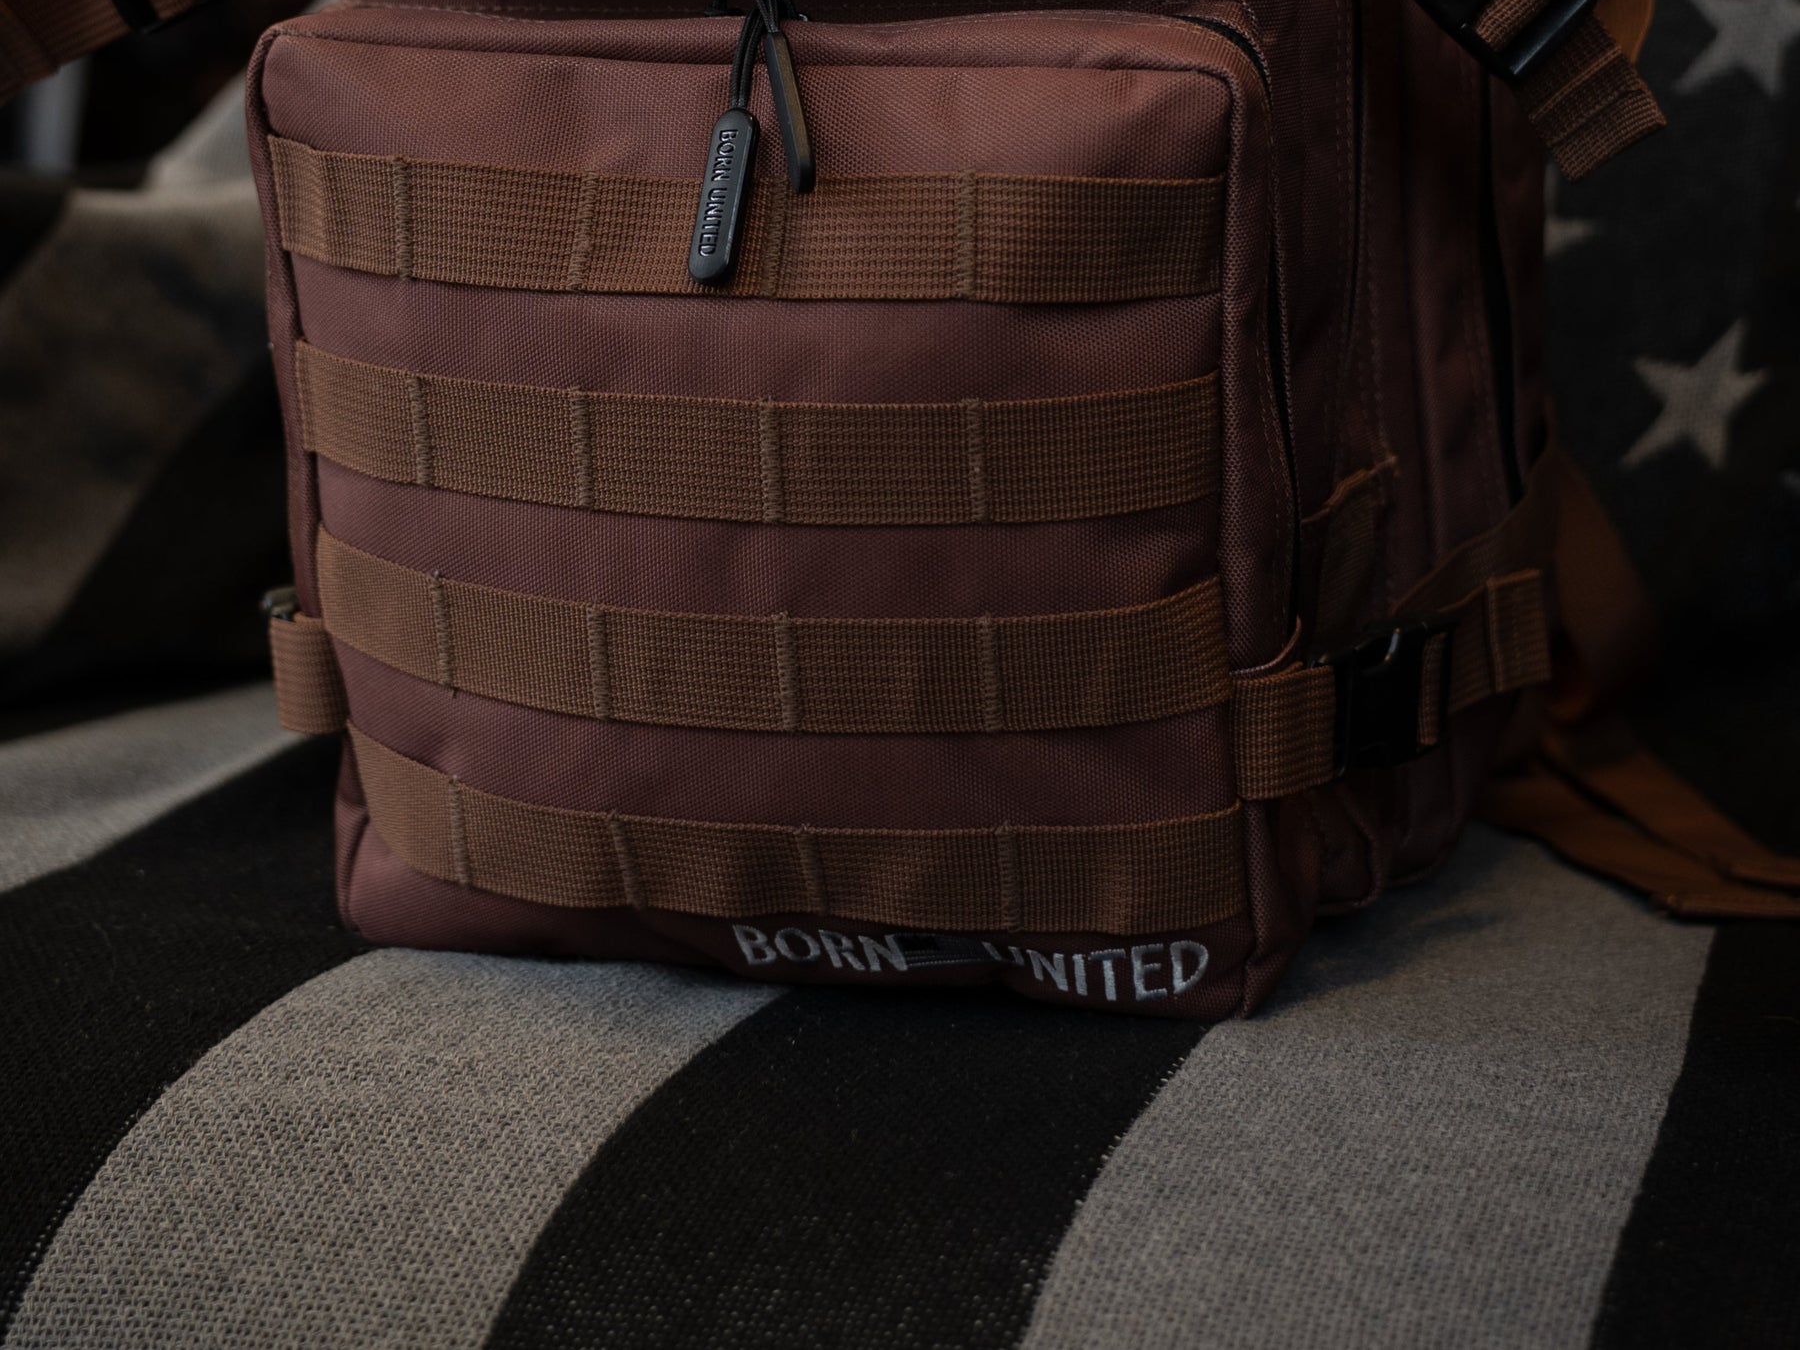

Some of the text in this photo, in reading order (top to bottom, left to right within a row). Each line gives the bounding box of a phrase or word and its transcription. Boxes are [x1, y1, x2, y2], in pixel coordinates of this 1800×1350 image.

[698, 129, 738, 257] BORN UNITED
[733, 925, 908, 972] BORN
